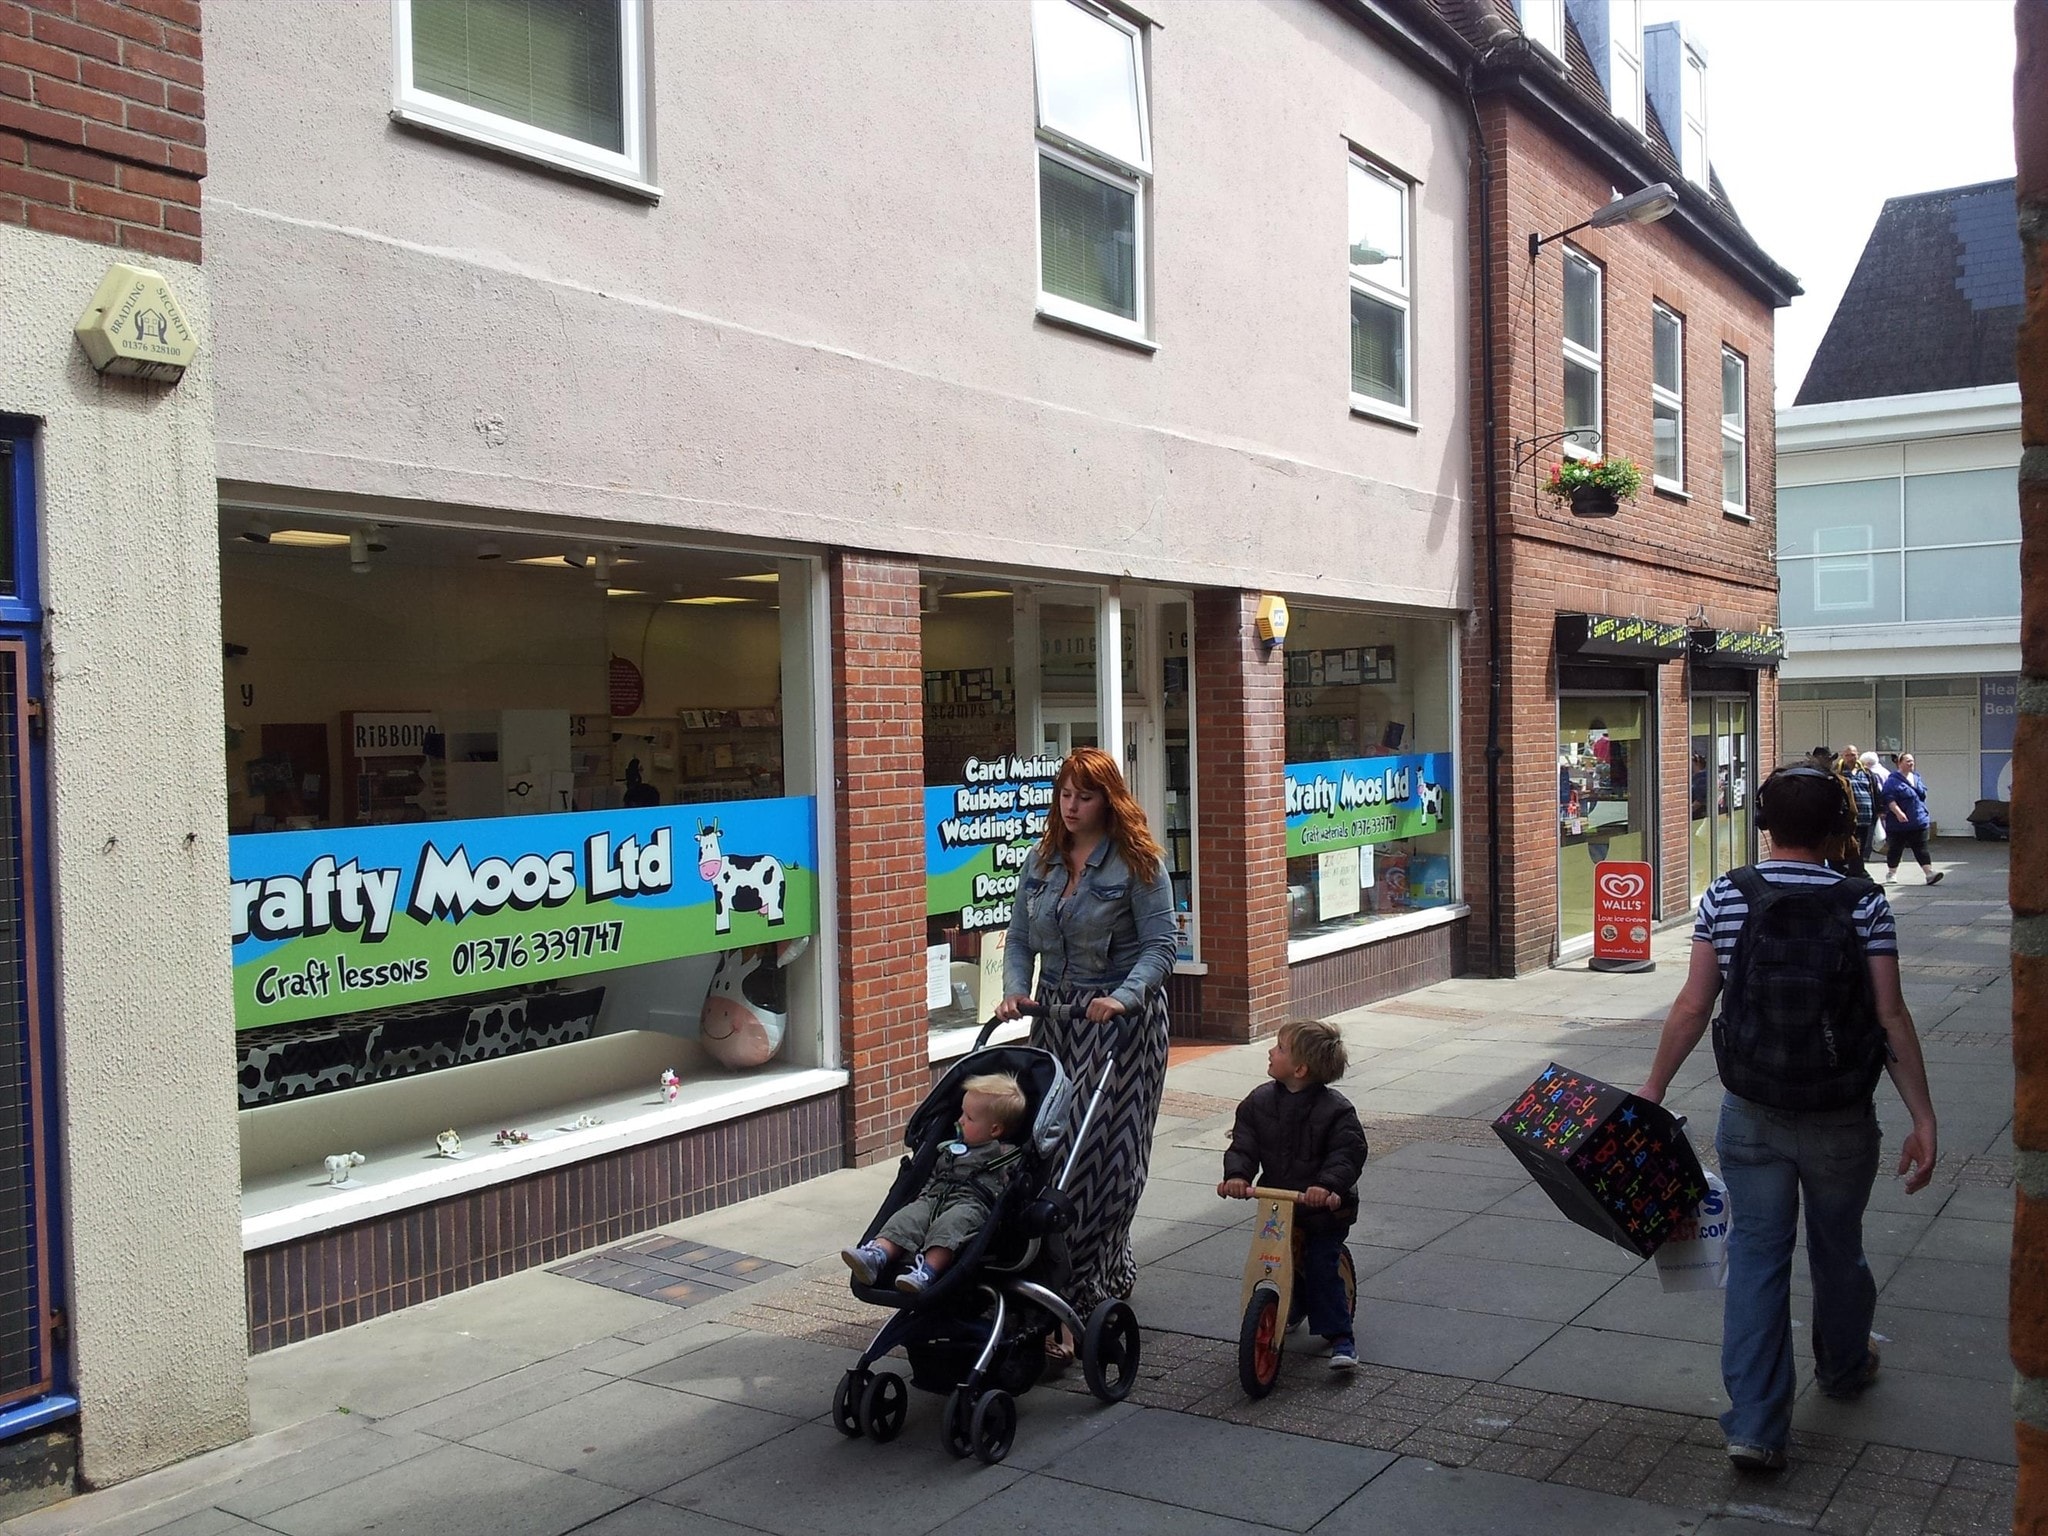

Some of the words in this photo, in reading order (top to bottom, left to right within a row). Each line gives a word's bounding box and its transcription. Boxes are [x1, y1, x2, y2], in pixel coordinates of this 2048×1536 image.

[110, 281, 145, 335] BRADLING
[156, 287, 191, 342] SECURITY
[122, 340, 148, 351] 01376
[150, 344, 181, 356] 328100
[1985, 683, 2015, 696] Hea
[1985, 702, 2014, 715] Bea
[965, 756, 1006, 782] Card
[956, 787, 1016, 812] Rubber
[1285, 774, 1337, 818] Krafty
[1339, 769, 1383, 812] Moos
[1384, 766, 1410, 804] Ltd
[941, 816, 1023, 845] Weddings
[1301, 826, 1319, 845] Craft
[231, 855, 402, 943] rafty
[406, 840, 577, 926] Moos
[584, 826, 672, 904] Ltd
[961, 901, 1012, 930] Beads
[1602, 900, 1642, 910] WALL'S
[255, 958, 331, 1005] Craft
[337, 954, 429, 992] lessons
[453, 935, 528, 976] 01376
[530, 921, 625, 964] 339747
[1542, 1078, 1598, 1116] Happy
[1515, 1094, 1580, 1145] Birthday
[1623, 1128, 1683, 1201] Happy
[1594, 1138, 1665, 1234] Birthday
